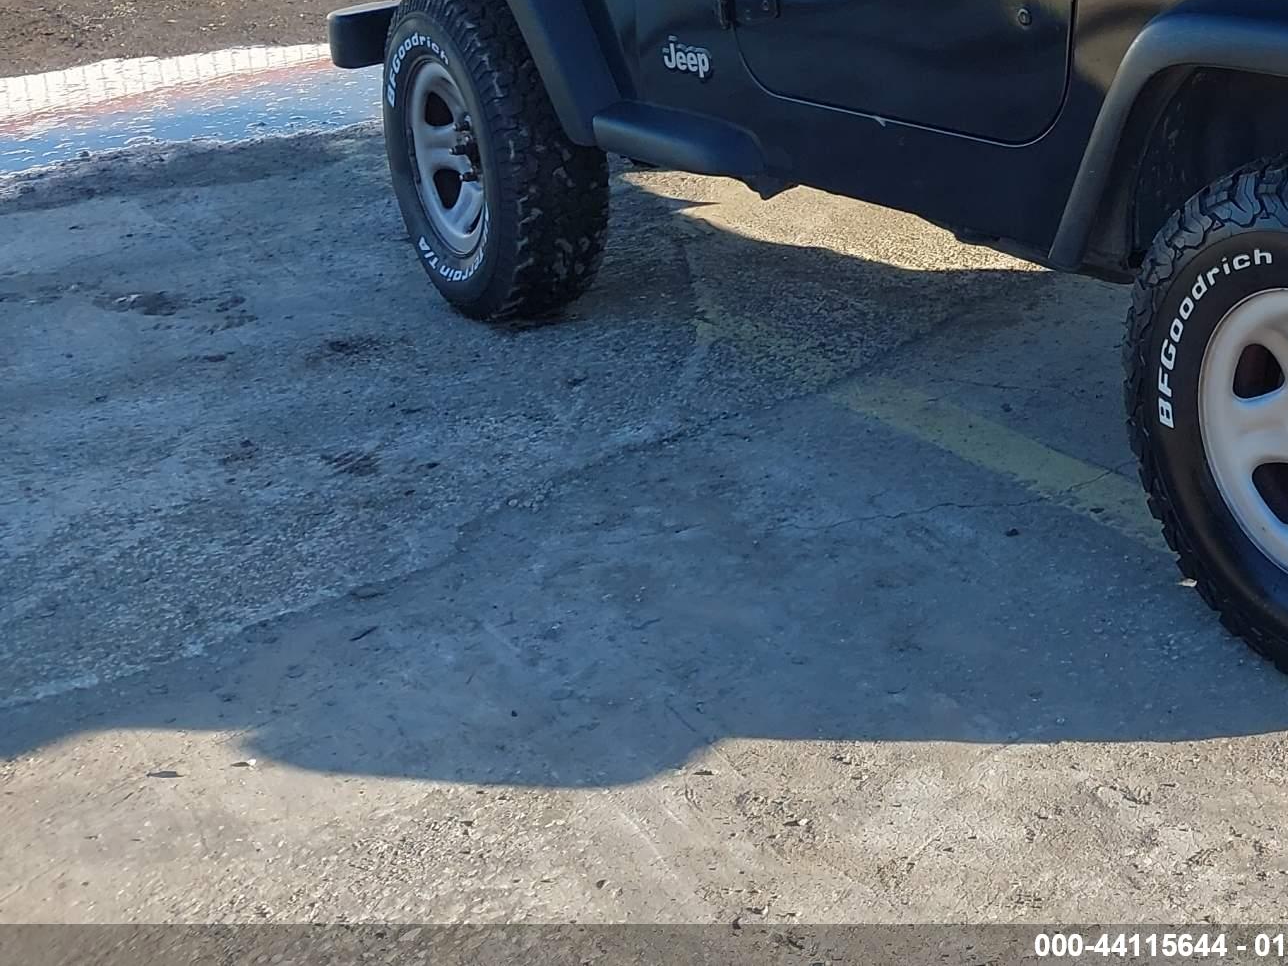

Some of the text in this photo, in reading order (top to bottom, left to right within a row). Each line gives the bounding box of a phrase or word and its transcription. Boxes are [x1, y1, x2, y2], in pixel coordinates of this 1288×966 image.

[387, 32, 449, 108] BFGoodrich
[663, 37, 711, 79] Jeep
[1157, 248, 1273, 429] BFGoodrich
